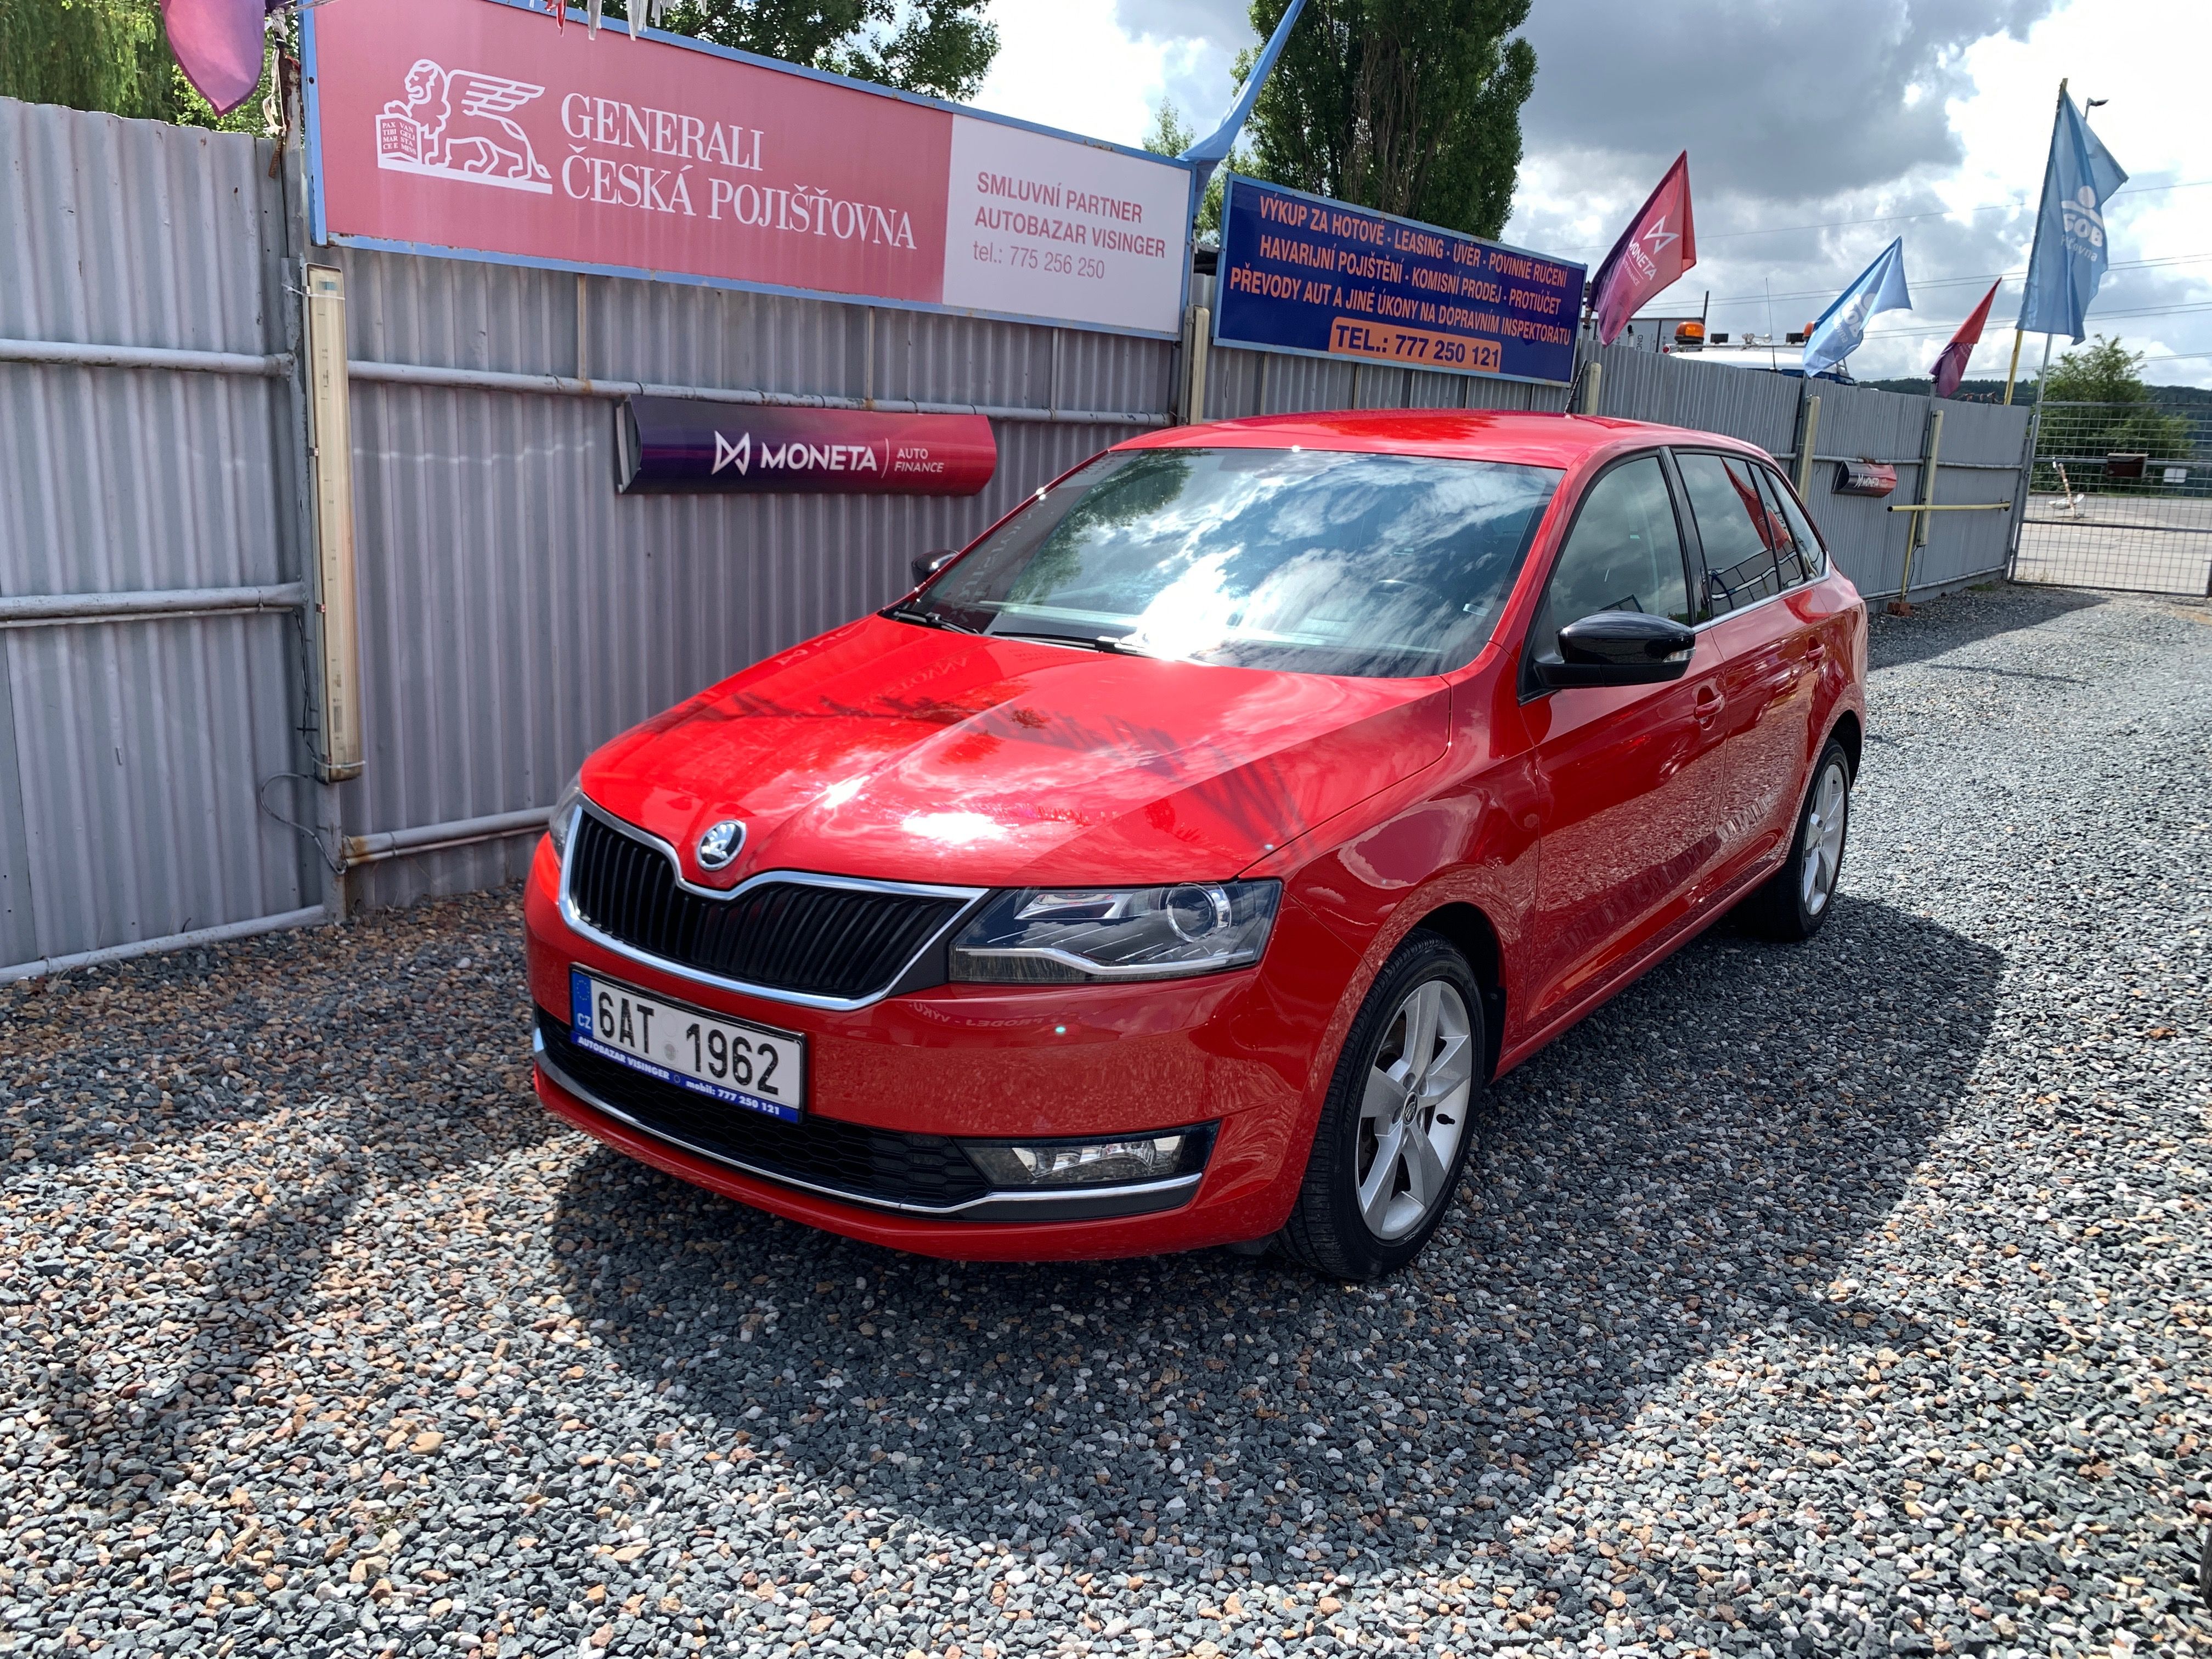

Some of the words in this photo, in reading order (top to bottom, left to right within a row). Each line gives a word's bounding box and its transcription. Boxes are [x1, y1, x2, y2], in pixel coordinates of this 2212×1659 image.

[561, 92, 764, 171] GENERALI
[561, 143, 697, 216] ČESKÁ
[707, 178, 917, 250] POJIŠŤOVNA
[977, 171, 1062, 207] SMLUVNÍ
[1066, 189, 1143, 224] PARTNER
[974, 206, 1087, 245] AUTOBAZAR
[1092, 227, 1166, 259] VISINGER
[1260, 193, 1307, 228] VÝKUP
[1310, 208, 1328, 234] ZA
[1331, 213, 1385, 246] HOTOVÉ
[1394, 228, 1444, 259] LEASING
[1453, 239, 1481, 267] ÚVĚR
[1488, 252, 1533, 280] POVINNÉ
[1533, 258, 1569, 288] RUČENÍ
[1629, 237, 1657, 281] MONETA
[973, 240, 1003, 264] tel.:
[1010, 246, 1039, 269] 775
[1044, 251, 1073, 274] 256
[1077, 257, 1105, 279] 250
[1260, 234, 1337, 270] HAVARIJNÍ
[1338, 250, 1404, 284] POJIŠTĚNÍ
[1411, 267, 1462, 295] KOMISNÍ
[1461, 278, 1502, 304] PRODEJ
[1509, 289, 1562, 315] PROTIÚČET
[1229, 262, 1302, 301] PŘEVODY
[1303, 281, 1332, 306] AUT
[1333, 286, 1342, 308] A
[1345, 285, 1375, 313] JINÉ
[1377, 287, 1419, 320] ÚKONY
[1419, 301, 1436, 323] NA
[1438, 304, 1500, 334] DOPRAVNÍM
[1500, 316, 1571, 346] INSPEKTORÁTU
[1336, 324, 1389, 353] TEL.:
[1395, 334, 1429, 357] 777
[1433, 340, 1465, 363] 250
[1472, 346, 1499, 368] 121
[760, 442, 878, 471] MONETA
[894, 461, 945, 473] FINANCE
[896, 448, 929, 460] AUTO
[577, 1013, 592, 1030] CZ
[599, 991, 654, 1054] 6AT
[686, 1023, 779, 1096] 1962
[578, 1036, 627, 1063] AUTOBAZAR
[627, 1057, 670, 1080] VISINGER
[686, 1080, 715, 1096] mobil:
[718, 1088, 737, 1102] 777
[739, 1096, 759, 1109] 250
[762, 1102, 780, 1115] 121
